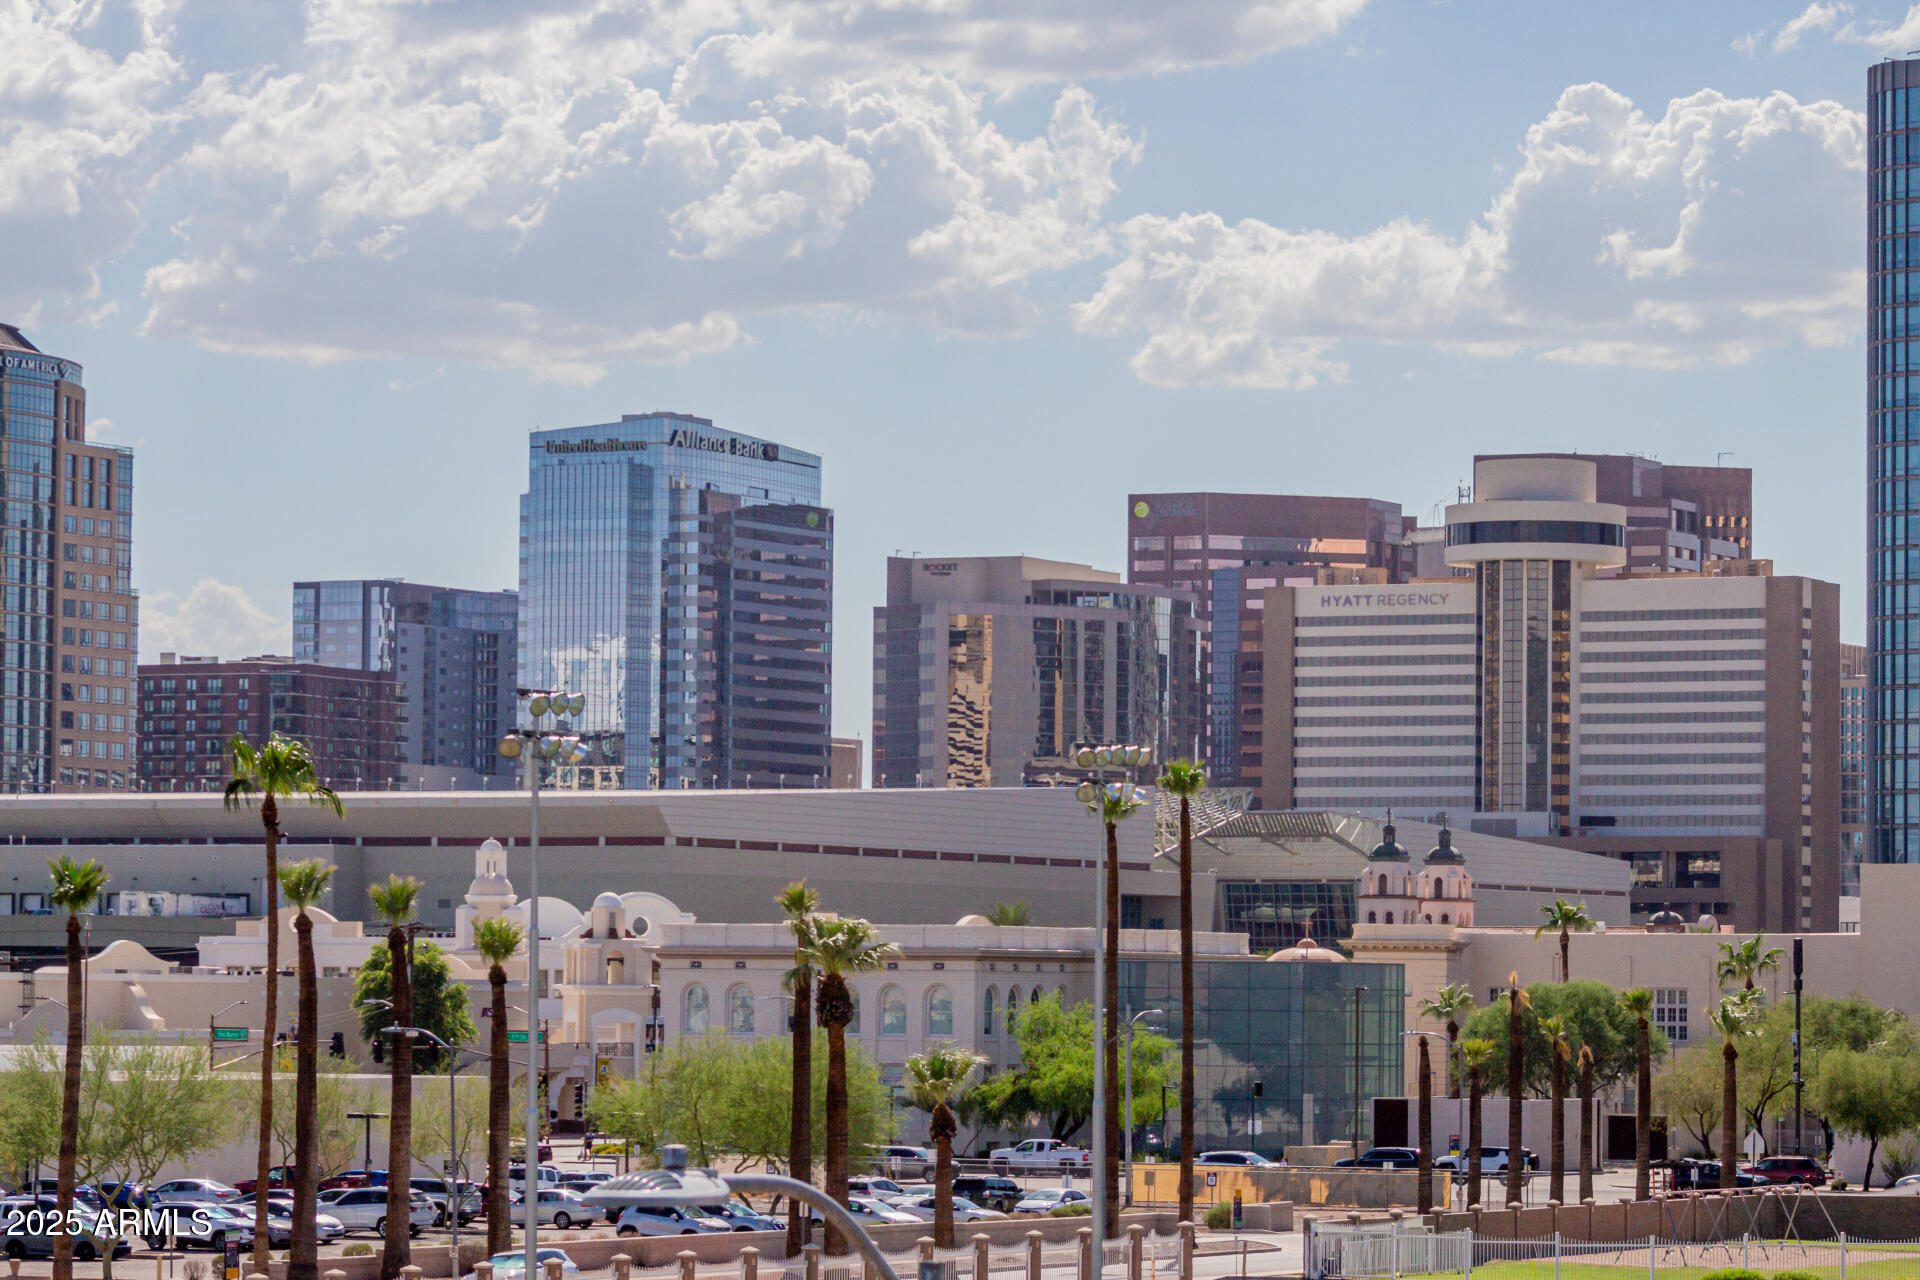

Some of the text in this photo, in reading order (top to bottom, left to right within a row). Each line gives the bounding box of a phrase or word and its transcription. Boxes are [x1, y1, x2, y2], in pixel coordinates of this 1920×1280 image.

[6, 356, 20, 368] OF
[21, 359, 58, 374] AMERICA
[672, 429, 765, 460] Alliance Bank
[1321, 593, 1449, 607] HYATT REGENCY
